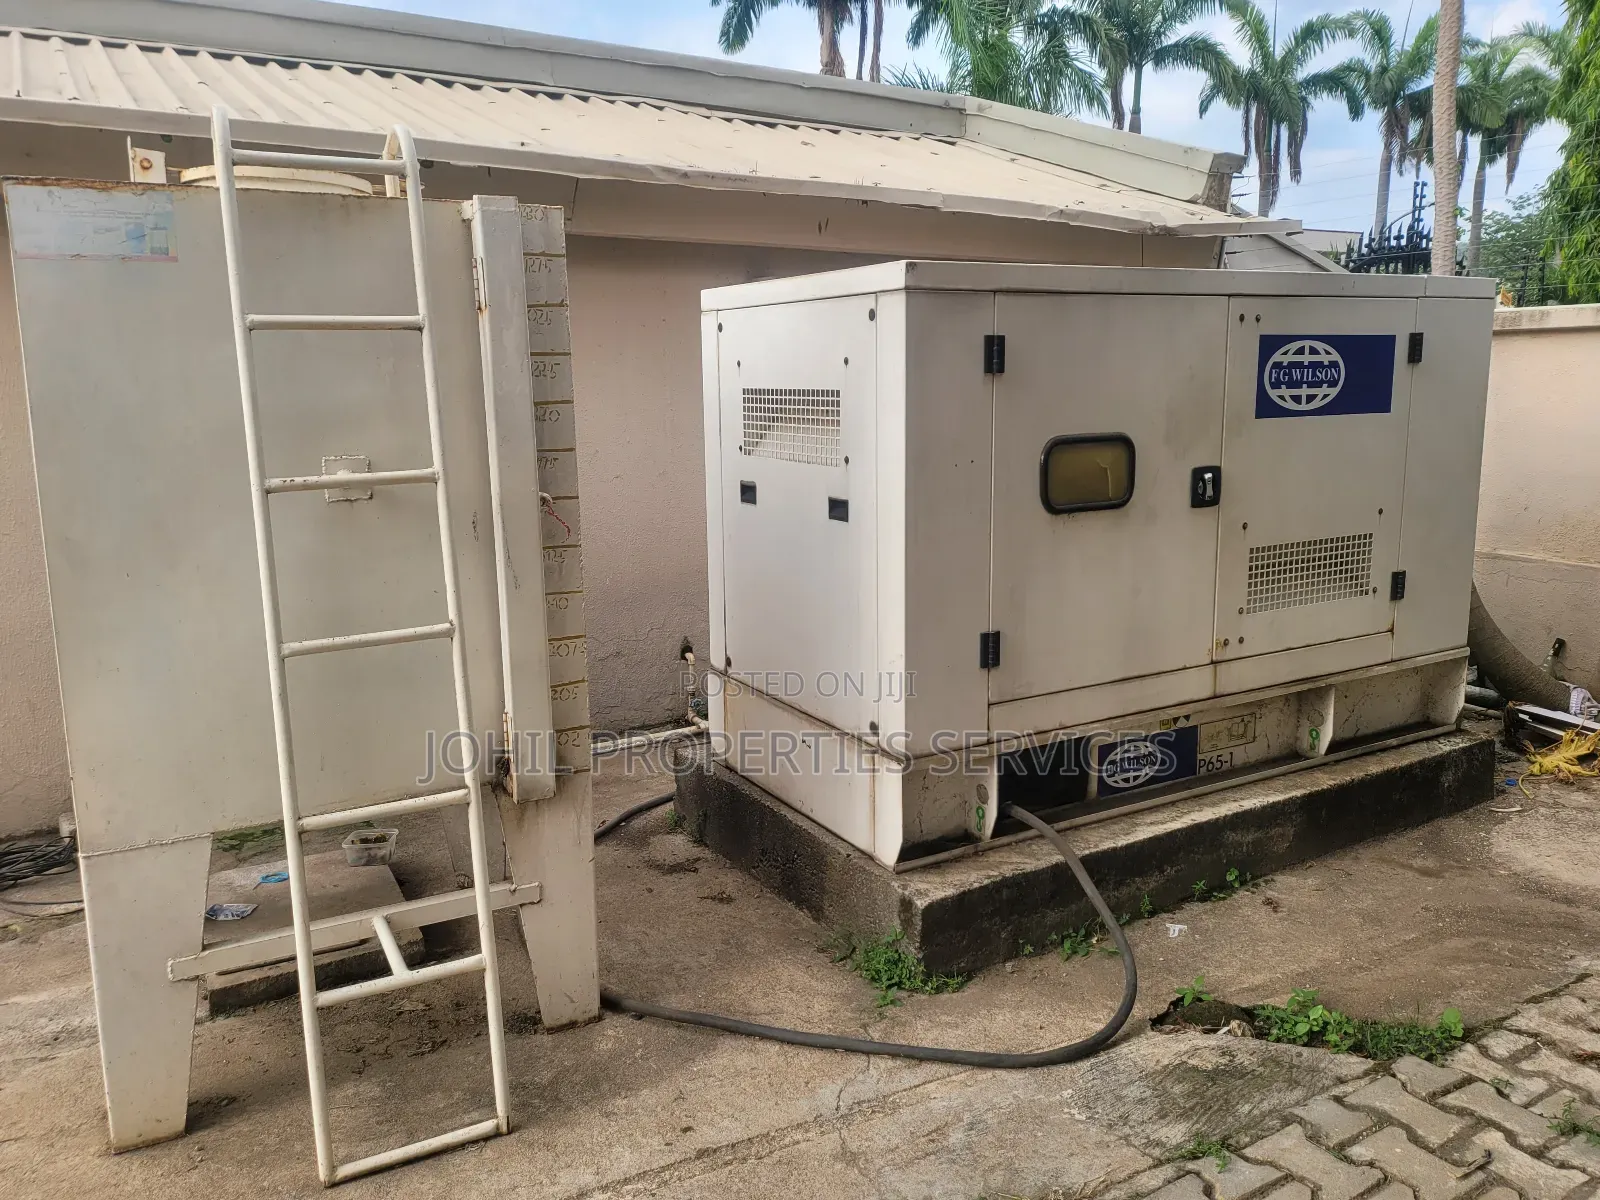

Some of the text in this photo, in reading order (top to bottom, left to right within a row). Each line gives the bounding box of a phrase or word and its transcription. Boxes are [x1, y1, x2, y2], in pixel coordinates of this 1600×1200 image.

[1270, 367, 1340, 383] FG WILSON
[1197, 751, 1234, 775] P65-1
